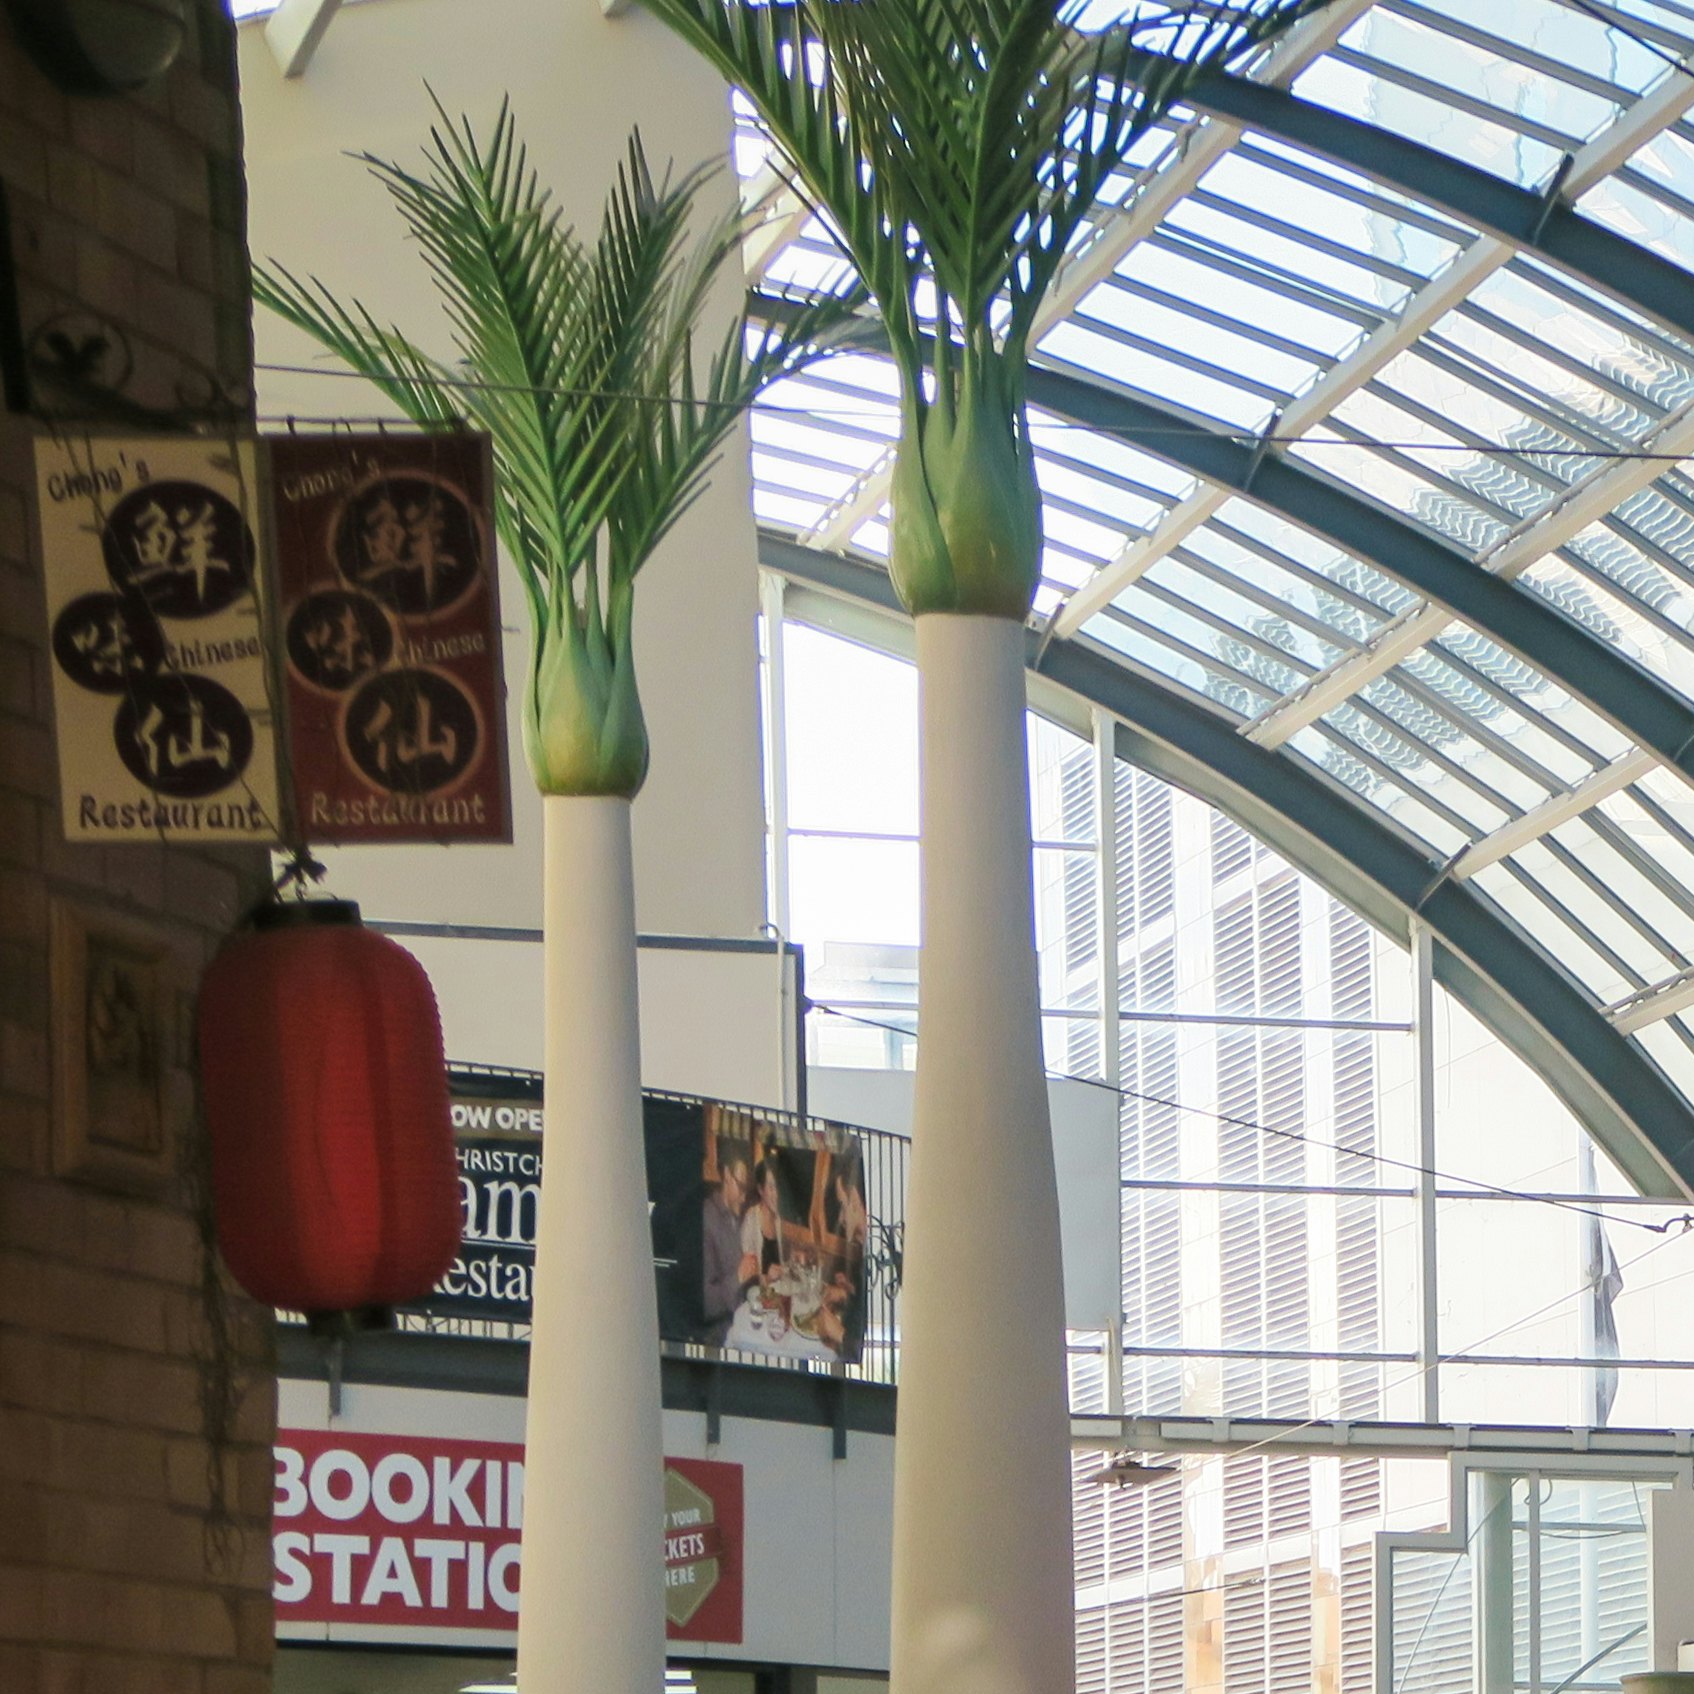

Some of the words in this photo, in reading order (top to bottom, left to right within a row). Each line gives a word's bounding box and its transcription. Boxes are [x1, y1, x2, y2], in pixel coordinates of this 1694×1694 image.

[79, 794, 262, 830] Restaurant
[311, 791, 486, 825] Restaurant
[433, 1253, 537, 1302] esta
[671, 1508, 702, 1526] YOUR
[665, 1533, 706, 1560] KETS
